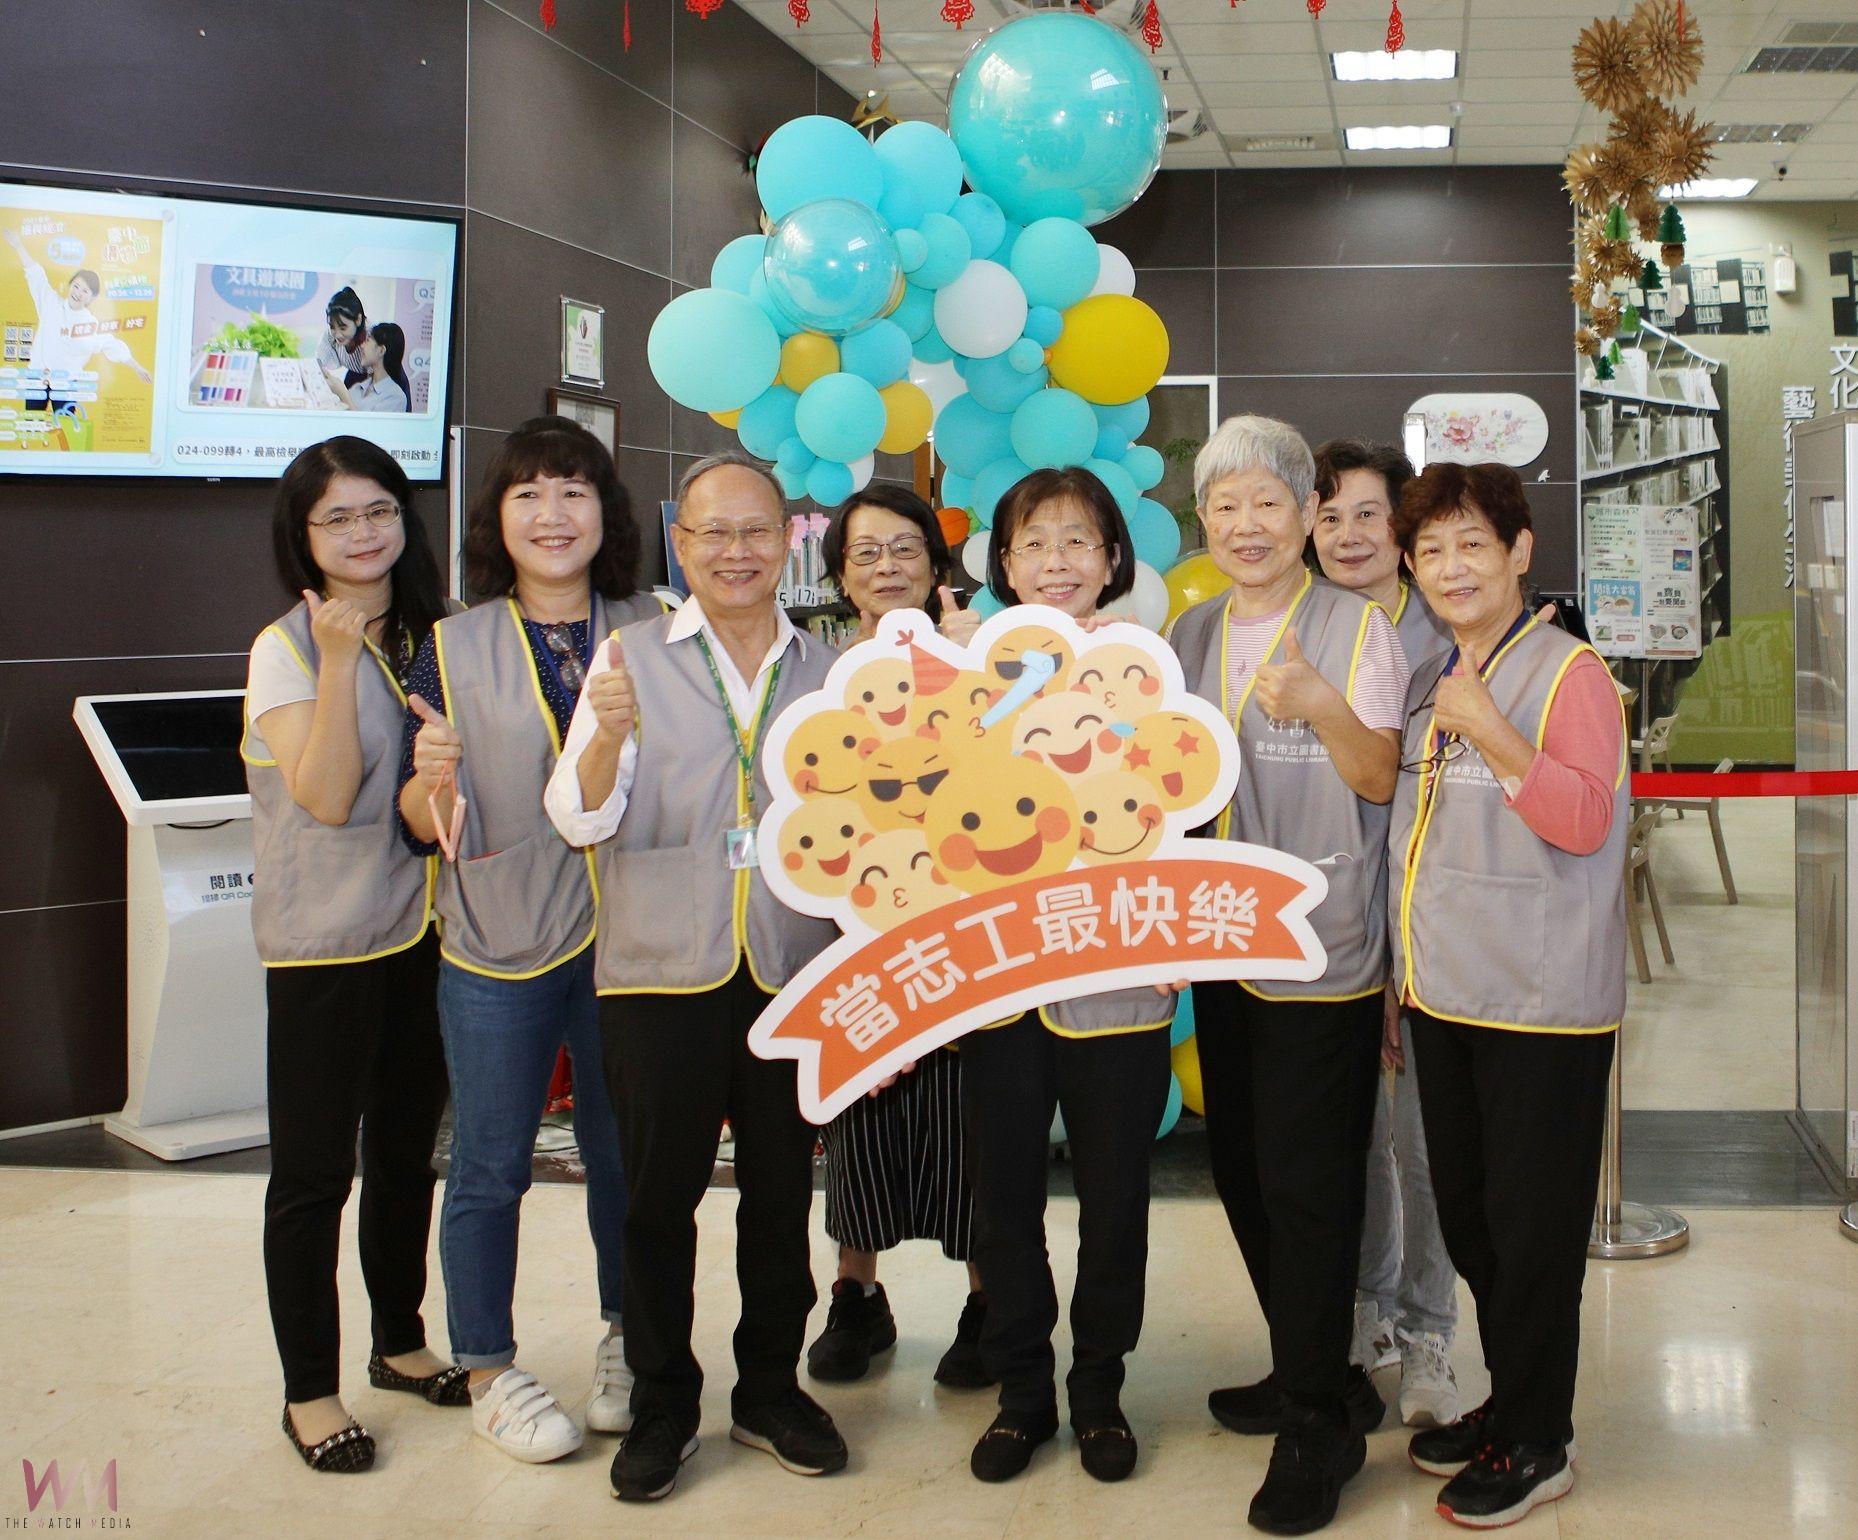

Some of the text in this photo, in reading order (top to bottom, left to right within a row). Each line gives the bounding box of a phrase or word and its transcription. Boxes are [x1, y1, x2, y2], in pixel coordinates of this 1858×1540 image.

[819, 876, 1259, 1053] 當志工最快樂
